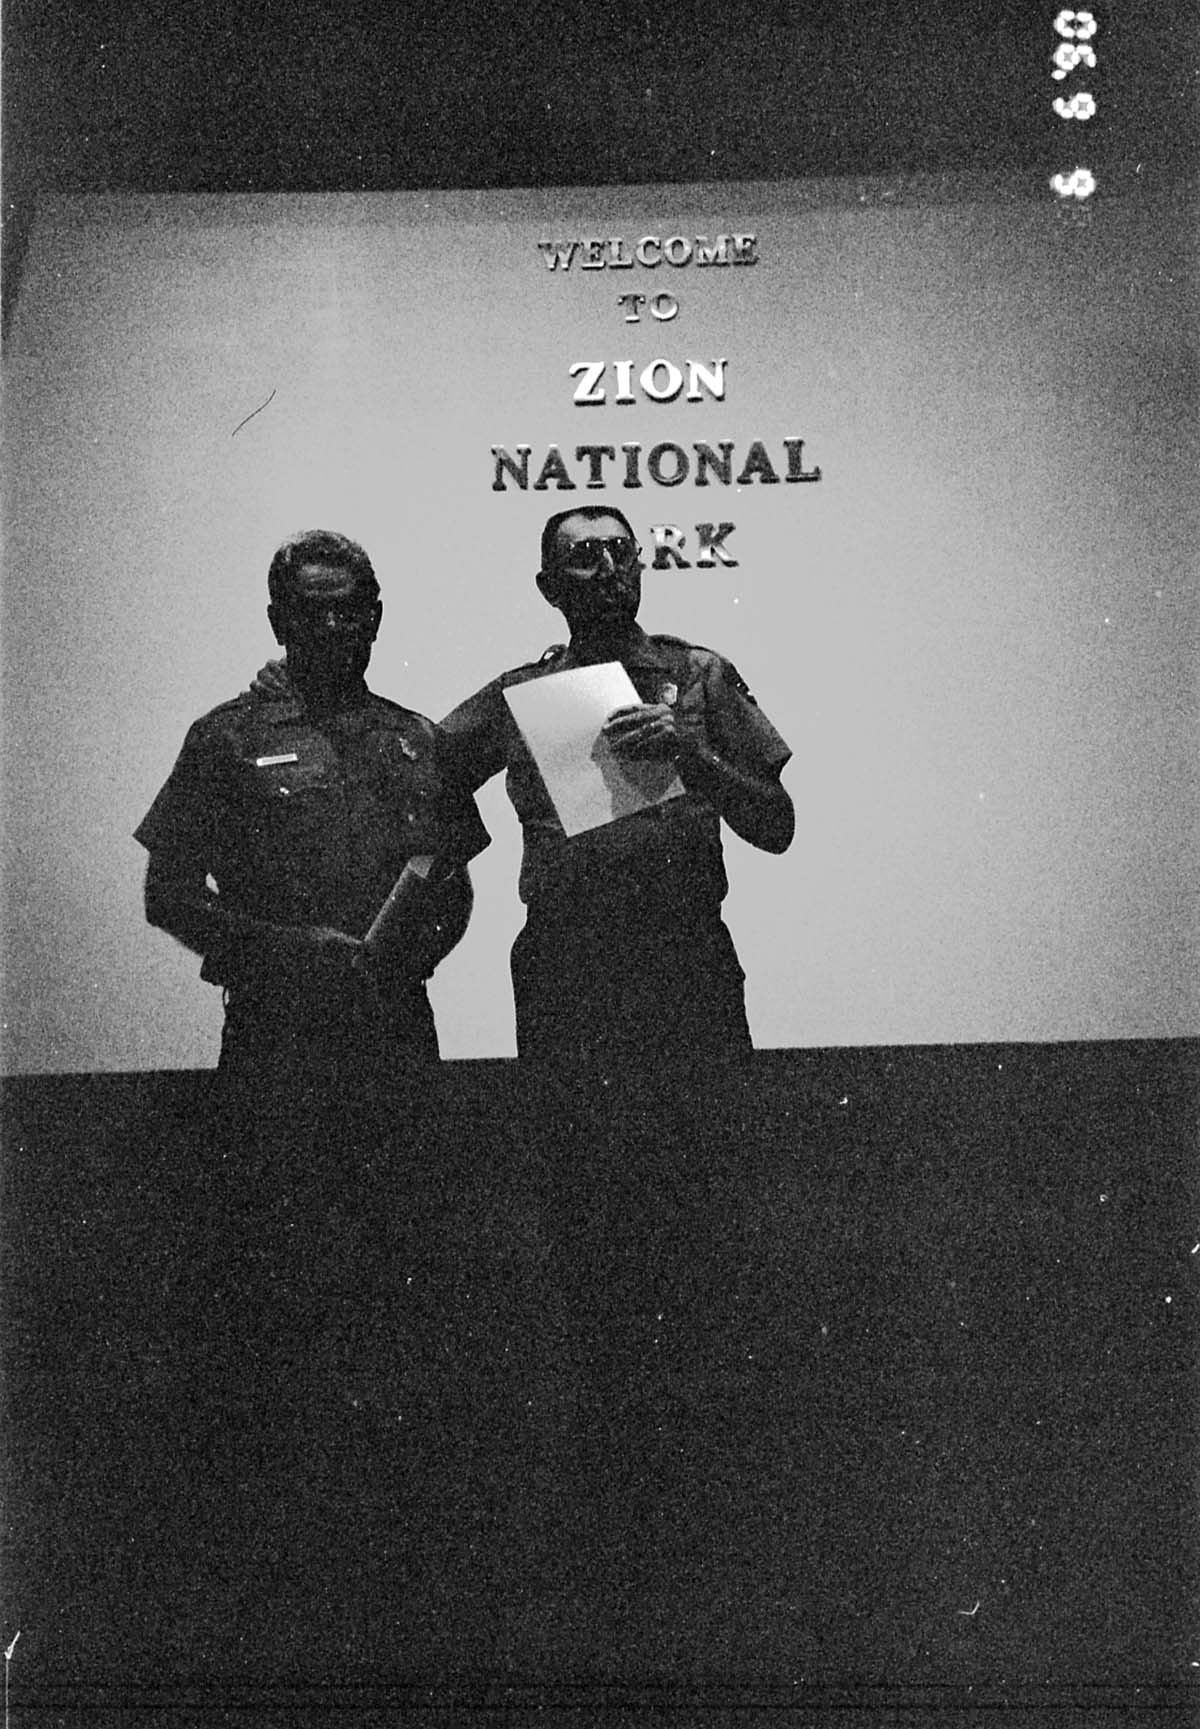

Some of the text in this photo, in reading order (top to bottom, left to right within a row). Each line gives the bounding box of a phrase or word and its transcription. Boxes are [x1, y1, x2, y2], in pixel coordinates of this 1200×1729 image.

[537, 233, 759, 271] WELCOME
[617, 292, 679, 324] TO
[568, 358, 728, 406] ZION
[490, 436, 822, 491] NATIONAL
[640, 522, 739, 570] RK
